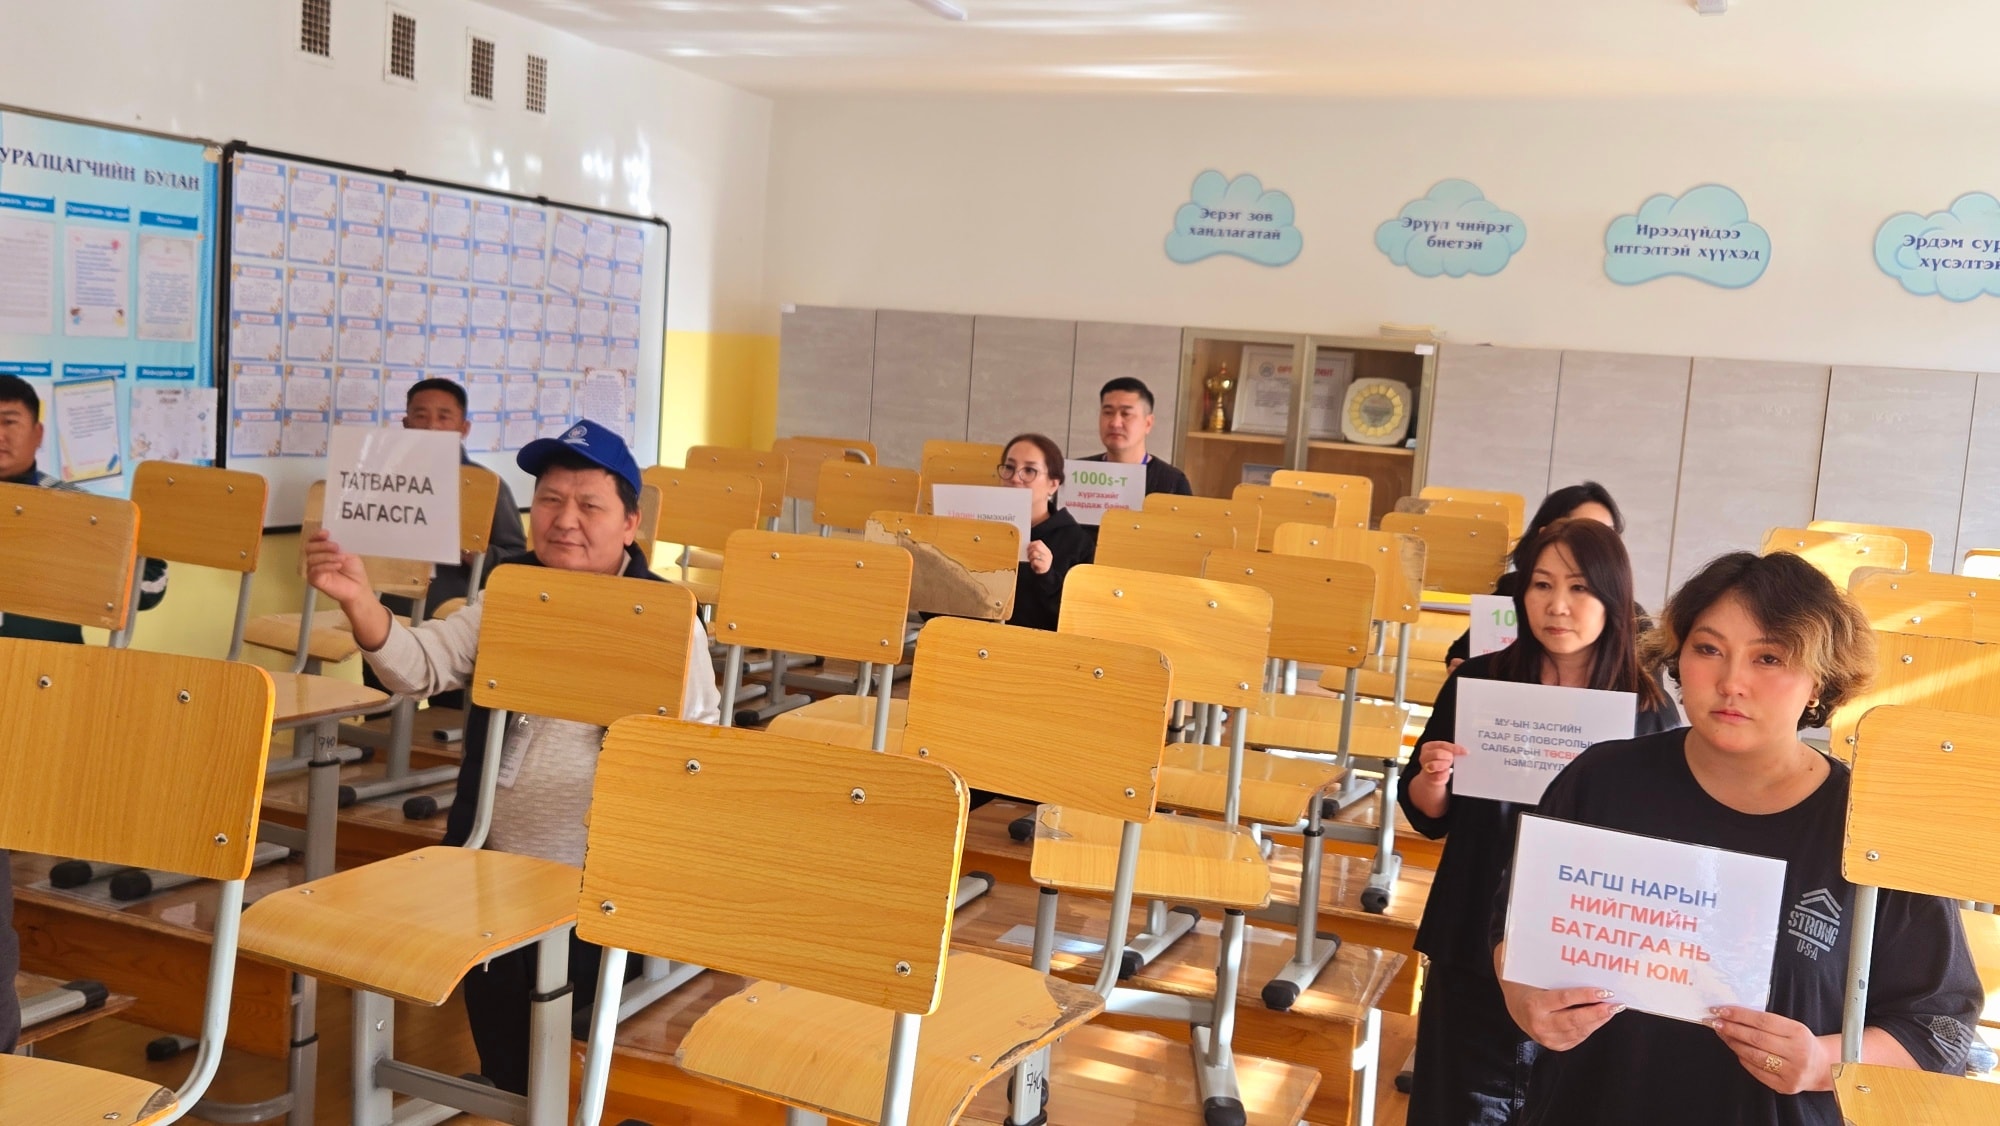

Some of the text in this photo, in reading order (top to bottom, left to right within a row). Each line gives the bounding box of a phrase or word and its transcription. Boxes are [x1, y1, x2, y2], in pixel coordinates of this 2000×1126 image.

[144, 169, 200, 192] БУЛАН
[1247, 211, 1273, 222] зов
[1188, 225, 1281, 241] хандлагатай
[1456, 219, 1513, 236] чийрэг
[1426, 234, 1483, 251] биетэй
[1613, 244, 1691, 258] итгэлтэй
[1902, 234, 1964, 251] Эрдэм
[340, 471, 434, 495] ТАТВАРАА
[341, 501, 428, 525] БАГАСГА
[1478, 730, 1511, 741] ГАЗАР
[1532, 721, 1582, 734] ЗАСГИЙН
[1481, 743, 1541, 756] САЛБАРЫН
[1558, 864, 1717, 908] БАГШ НАРЫН
[1570, 893, 1698, 933] НИЙГМИЙН
[1787, 910, 1839, 946] STRONG
[1551, 916, 1711, 963] БАТАЛГАА НЬ
[1561, 945, 1694, 986] ЦАЛИН ЮМ.
